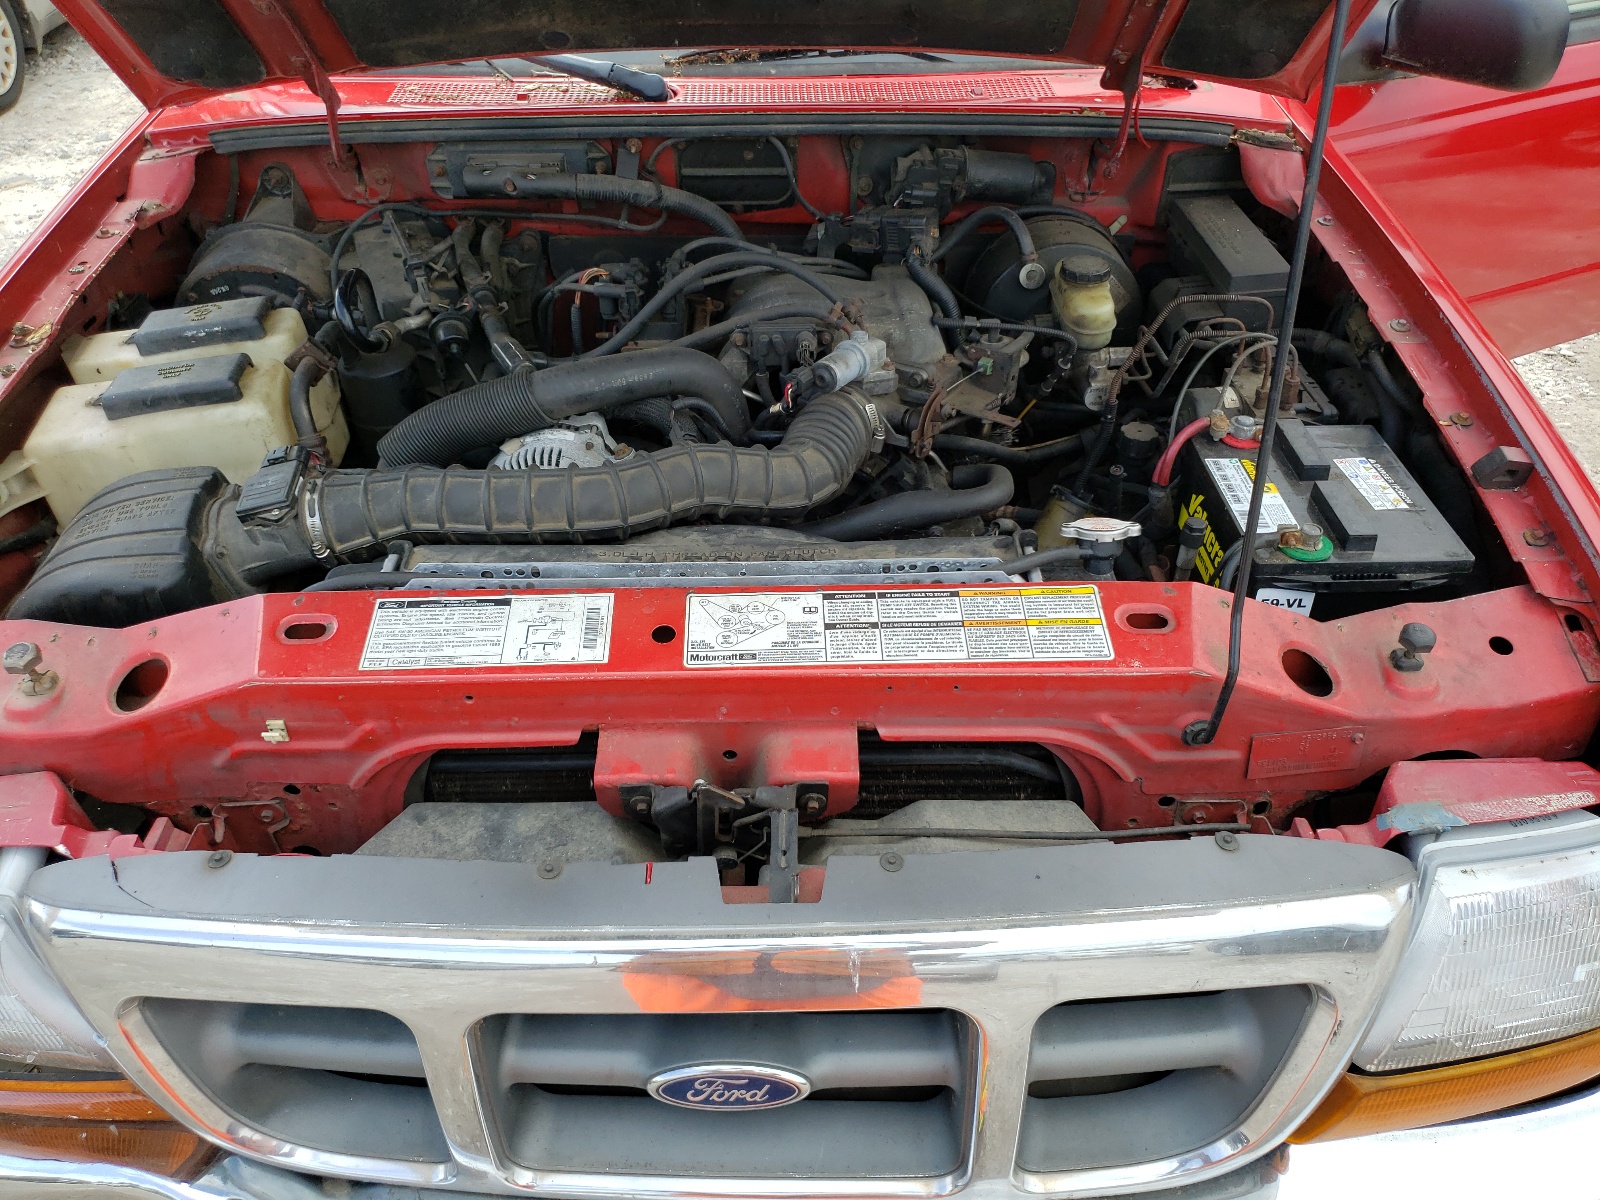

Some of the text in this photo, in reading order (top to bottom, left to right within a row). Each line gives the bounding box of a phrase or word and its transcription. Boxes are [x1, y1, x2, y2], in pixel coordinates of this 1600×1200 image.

[391, 658, 421, 666] Catalyst
[690, 653, 739, 662] Motorcraft
[686, 1077, 771, 1102] Ford
